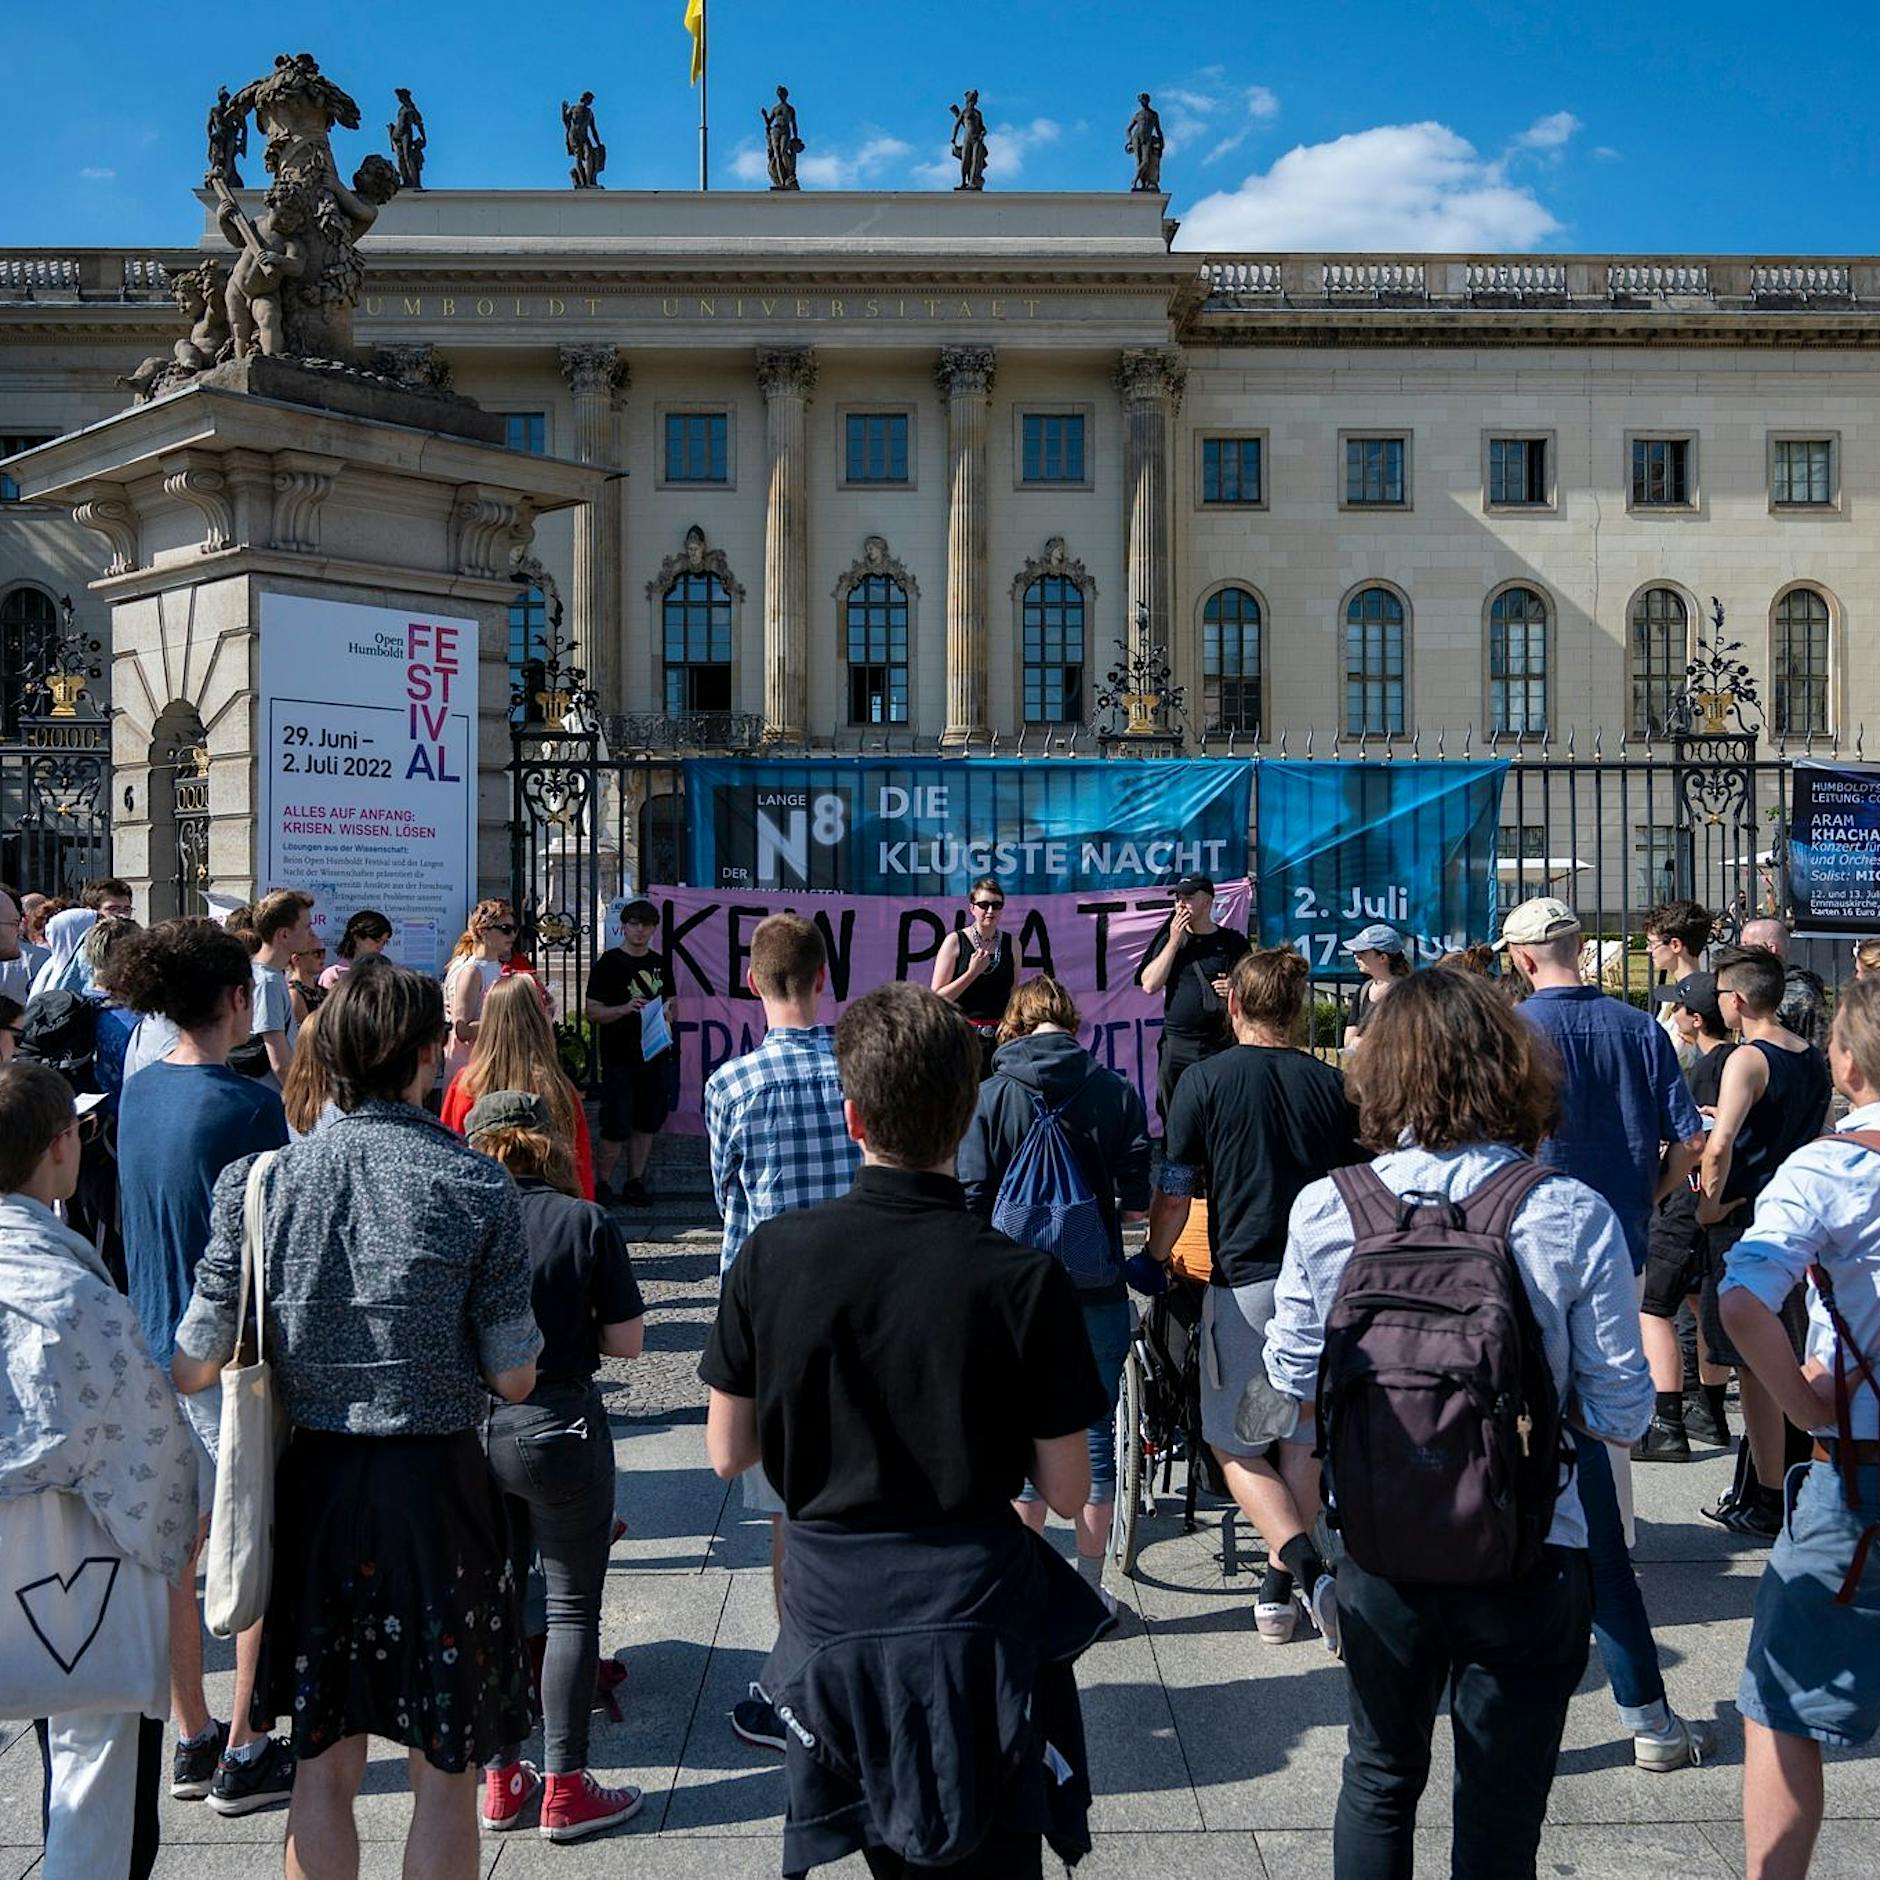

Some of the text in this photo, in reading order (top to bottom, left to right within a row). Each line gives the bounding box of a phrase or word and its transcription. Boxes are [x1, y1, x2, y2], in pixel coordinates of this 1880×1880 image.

[366, 298, 1040, 318] UMBOLDT UNIVERSITAET
[375, 632, 404, 646] Open
[349, 642, 404, 659] Humboldt
[283, 725, 313, 746] 29.
[318, 728, 358, 749] Juni
[282, 753, 392, 778] 2. Juli 2022
[757, 795, 807, 806] LANGE
[879, 785, 949, 819] DIE
[1811, 793, 1865, 804] LEITUNG:
[283, 806, 415, 822] ALLES AUF ANFANG:
[1811, 814, 1855, 826] ARAM
[283, 822, 435, 838] KRISEN. WISSEN. LÖSEN
[1811, 828, 1880, 841] KHACHA
[282, 843, 322, 852] Lösungen
[339, 844, 353, 852] der
[1810, 841, 1861, 852] Konzert
[879, 831, 1227, 875] KLÜGSTE NACHT
[304, 856, 325, 866] Open
[326, 857, 363, 865] Humboldt
[1810, 854, 1836, 865] und
[305, 868, 318, 876] der
[722, 868, 748, 879] DER
[1810, 870, 1851, 881] Solist:
[1811, 890, 1826, 898] 12.
[1828, 890, 1847, 898] und
[1849, 890, 1863, 898] 13.
[1294, 885, 1408, 921] 2. Juli
[1810, 908, 1840, 916] Karten
[1842, 908, 1854, 916] 16
[1855, 908, 1876, 916] Euro
[661, 899, 856, 1002] KEN
